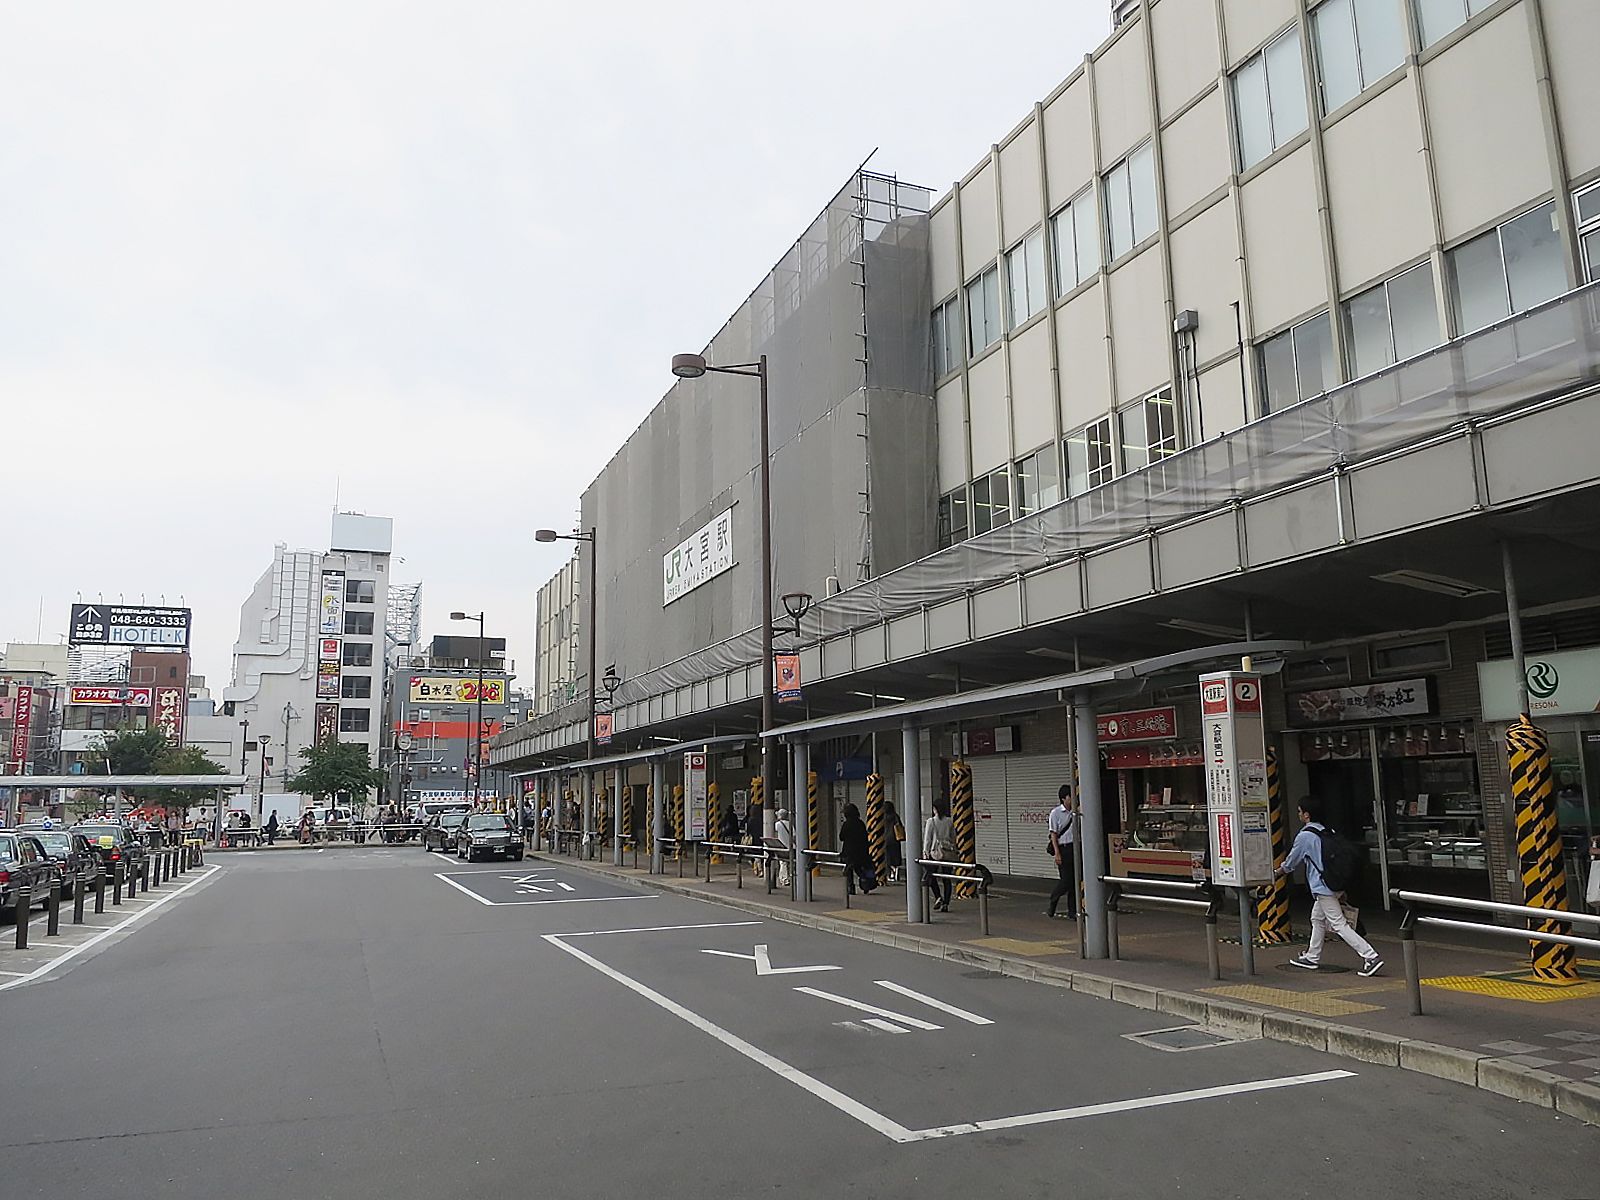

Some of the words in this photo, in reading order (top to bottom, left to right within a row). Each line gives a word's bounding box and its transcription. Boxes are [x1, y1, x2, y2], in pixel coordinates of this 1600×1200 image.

[110, 615, 186, 626] 048-640-3333
[420, 683, 452, 696] 白木屋
[1241, 684, 1251, 700] 2
[1530, 700, 1559, 709] RESONA
